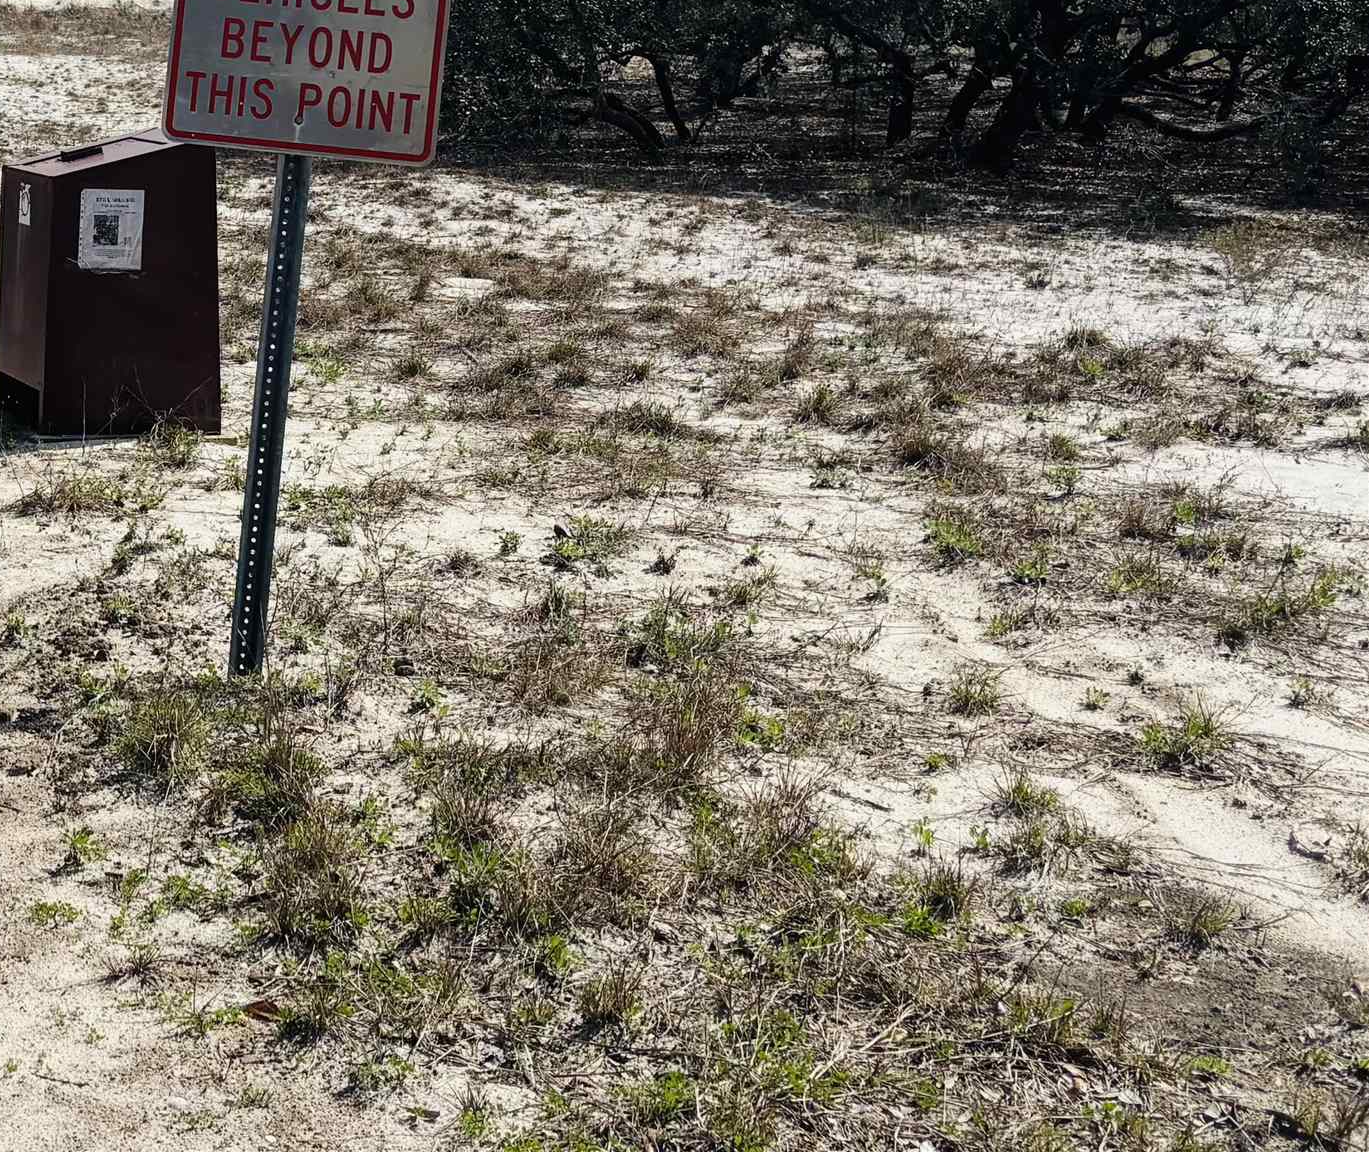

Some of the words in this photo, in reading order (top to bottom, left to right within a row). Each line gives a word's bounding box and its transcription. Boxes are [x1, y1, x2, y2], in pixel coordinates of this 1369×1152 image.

[220, 16, 393, 74] BEYOND
[186, 71, 275, 120] THIS
[296, 83, 421, 135] POINT
